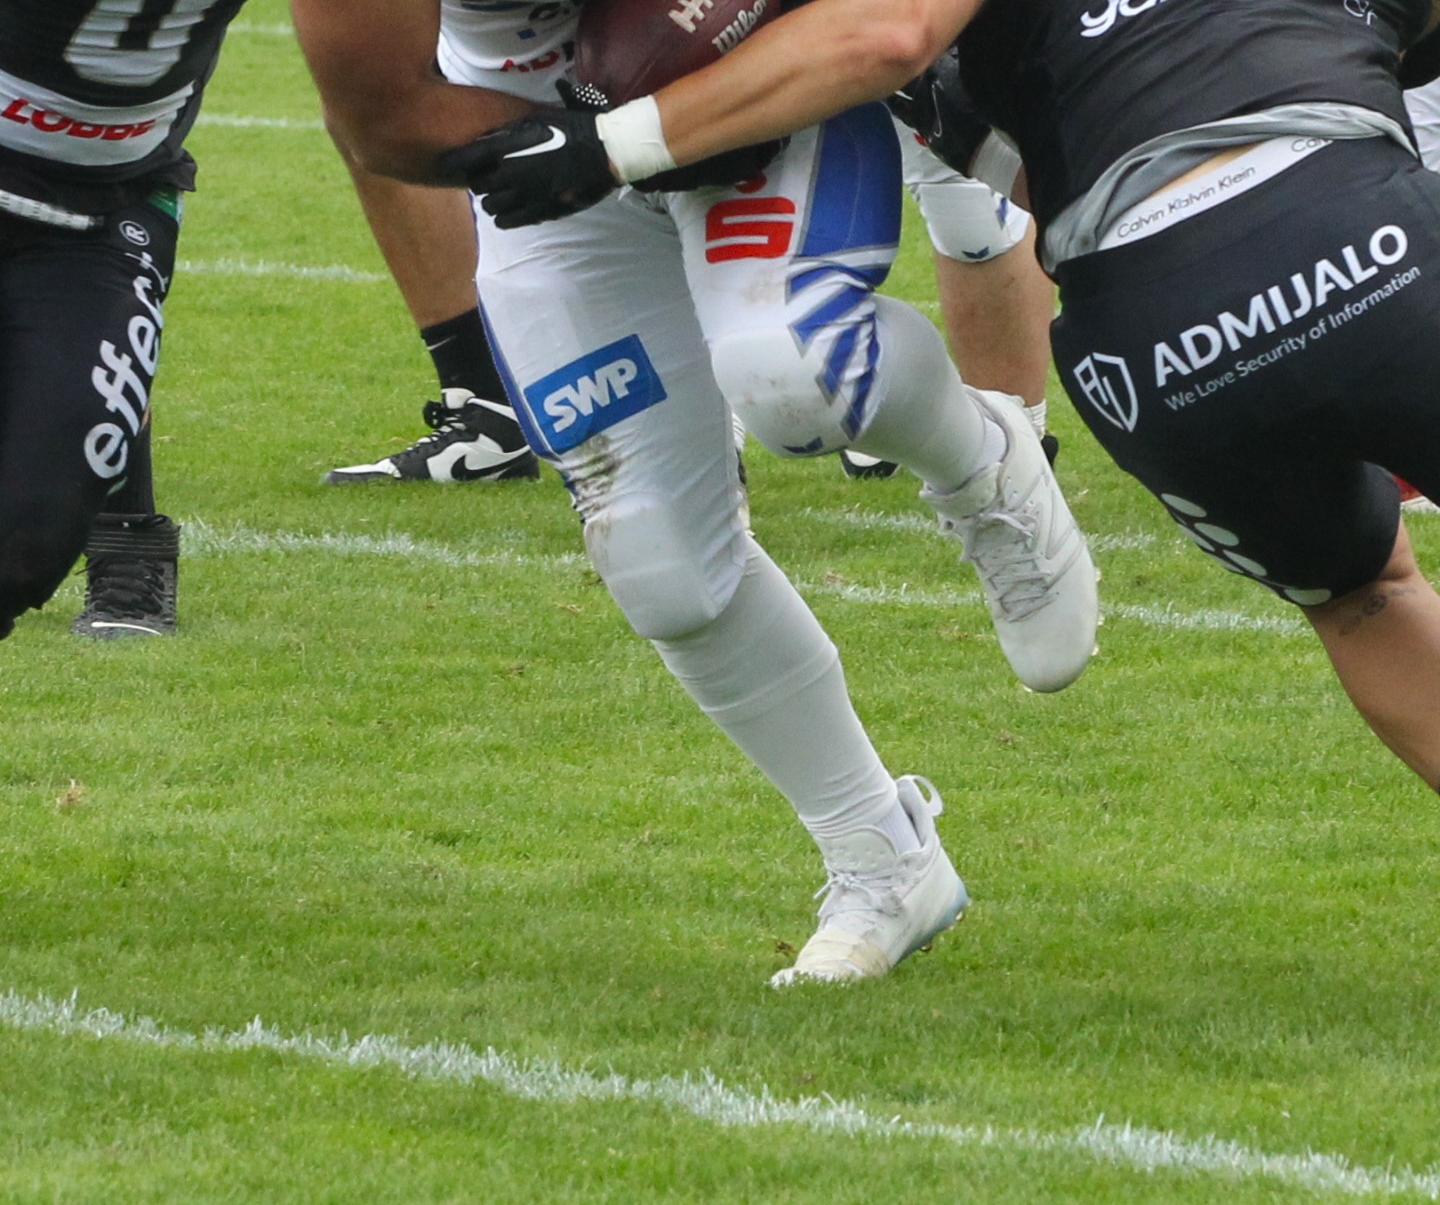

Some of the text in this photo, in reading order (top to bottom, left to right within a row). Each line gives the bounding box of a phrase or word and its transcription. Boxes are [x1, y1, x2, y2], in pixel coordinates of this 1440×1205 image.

[1117, 209, 1165, 239] Calvin
[1218, 165, 1257, 190] Klein
[1153, 224, 1408, 389] ADMIJALO
[1164, 265, 1421, 413] We Love Security of Information
[543, 357, 639, 434] SWP
